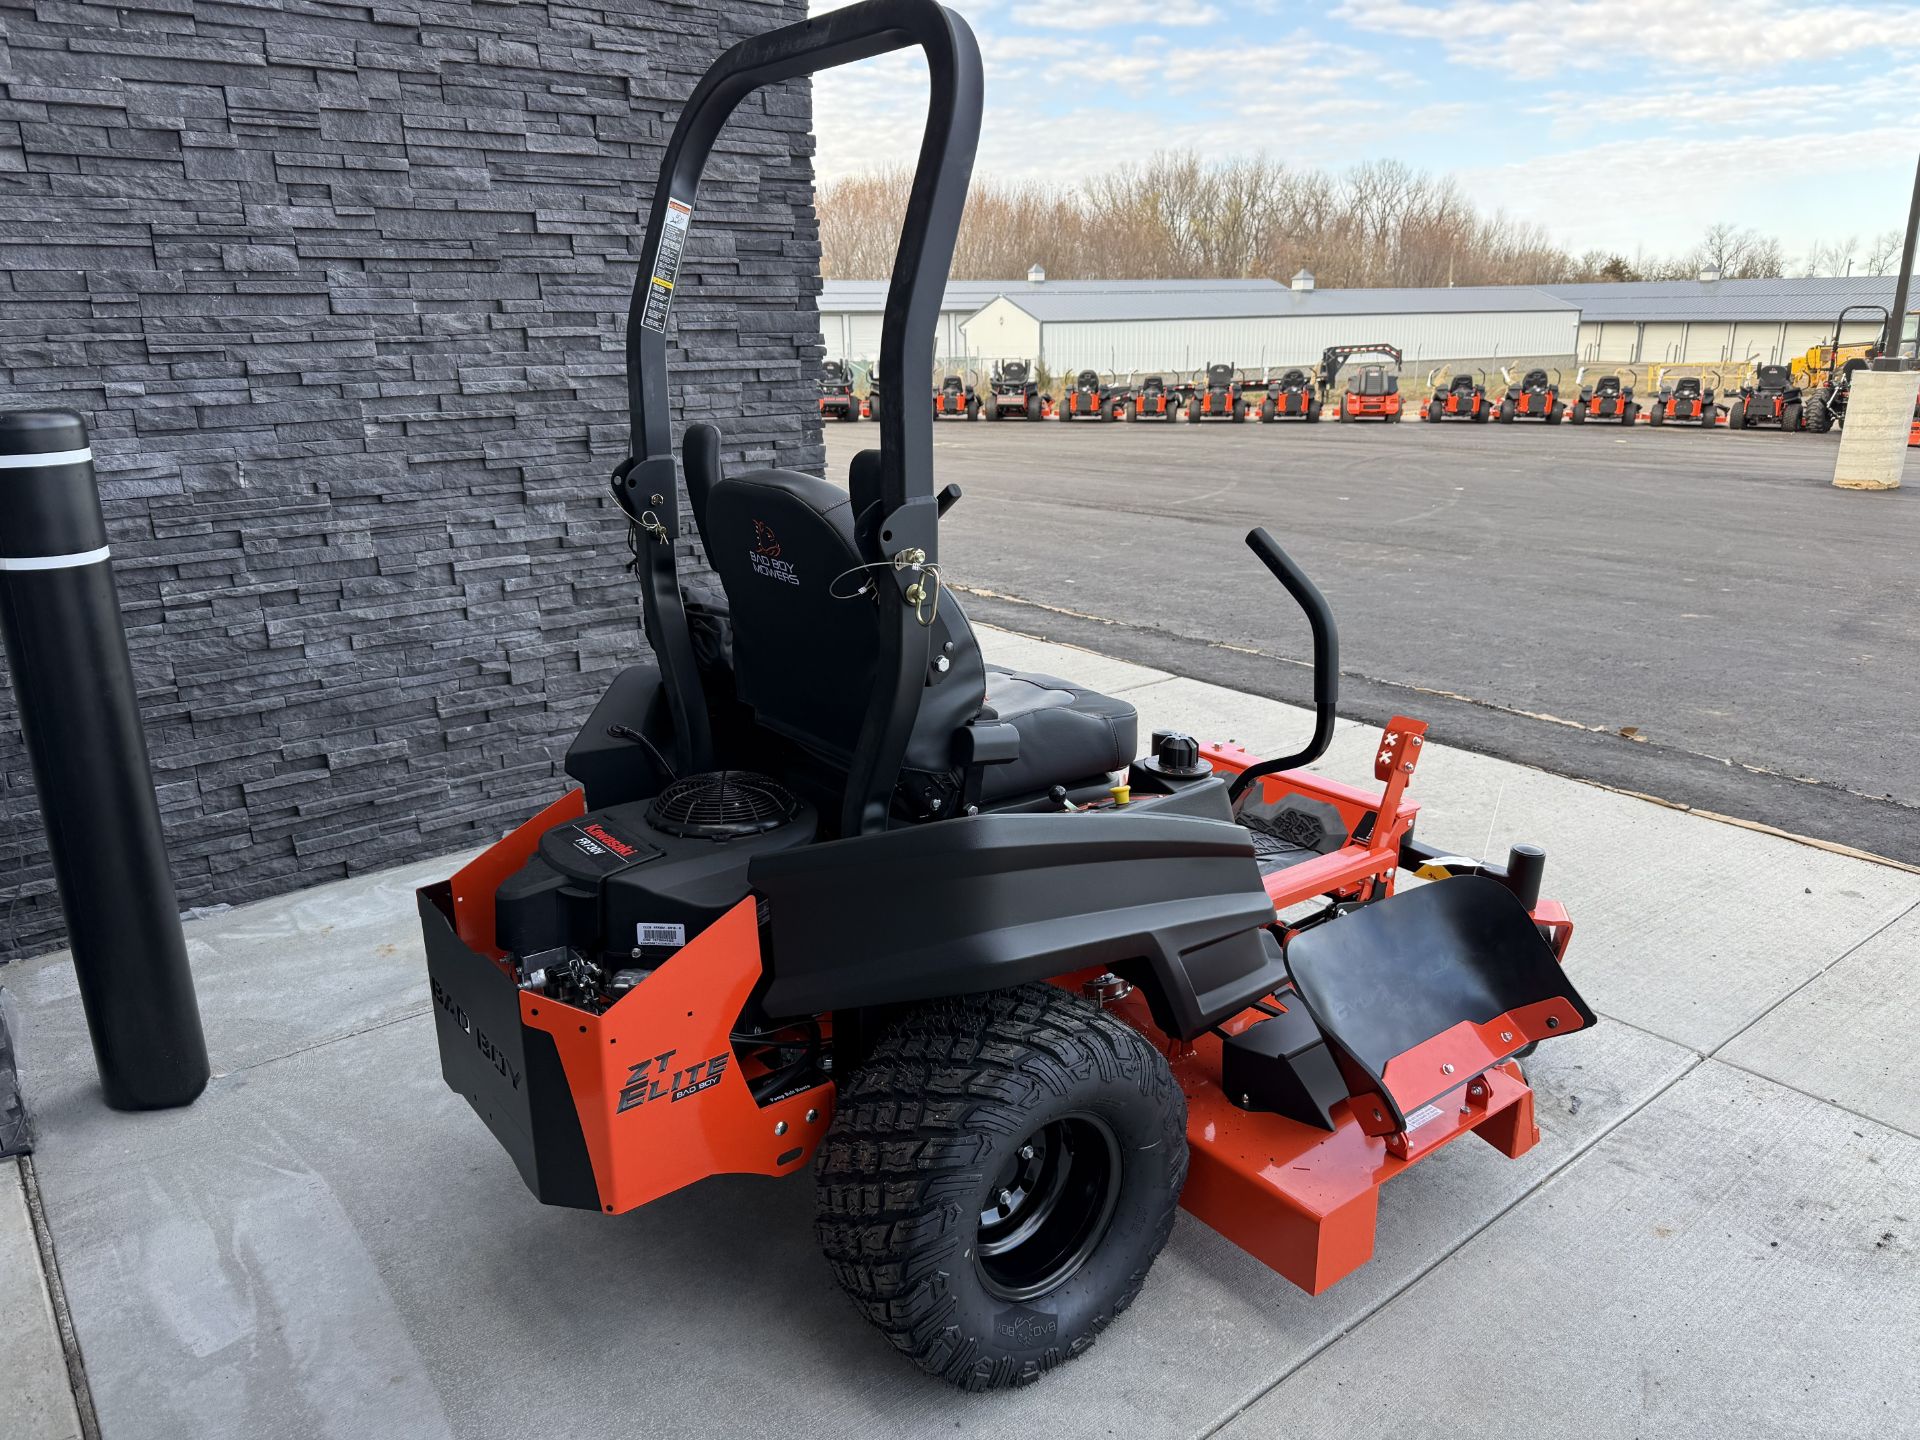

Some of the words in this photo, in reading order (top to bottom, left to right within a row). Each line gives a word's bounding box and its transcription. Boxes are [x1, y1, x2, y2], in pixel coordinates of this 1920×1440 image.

[749, 550, 770, 566] BAD
[770, 558, 794, 573] BOY
[752, 562, 800, 586] MOWERS
[583, 823, 638, 857] Kawasaki
[625, 1049, 677, 1086] ZT
[616, 1051, 730, 1114] ELITE
[676, 1085, 697, 1099] BAD
[698, 1076, 718, 1089] BOY
